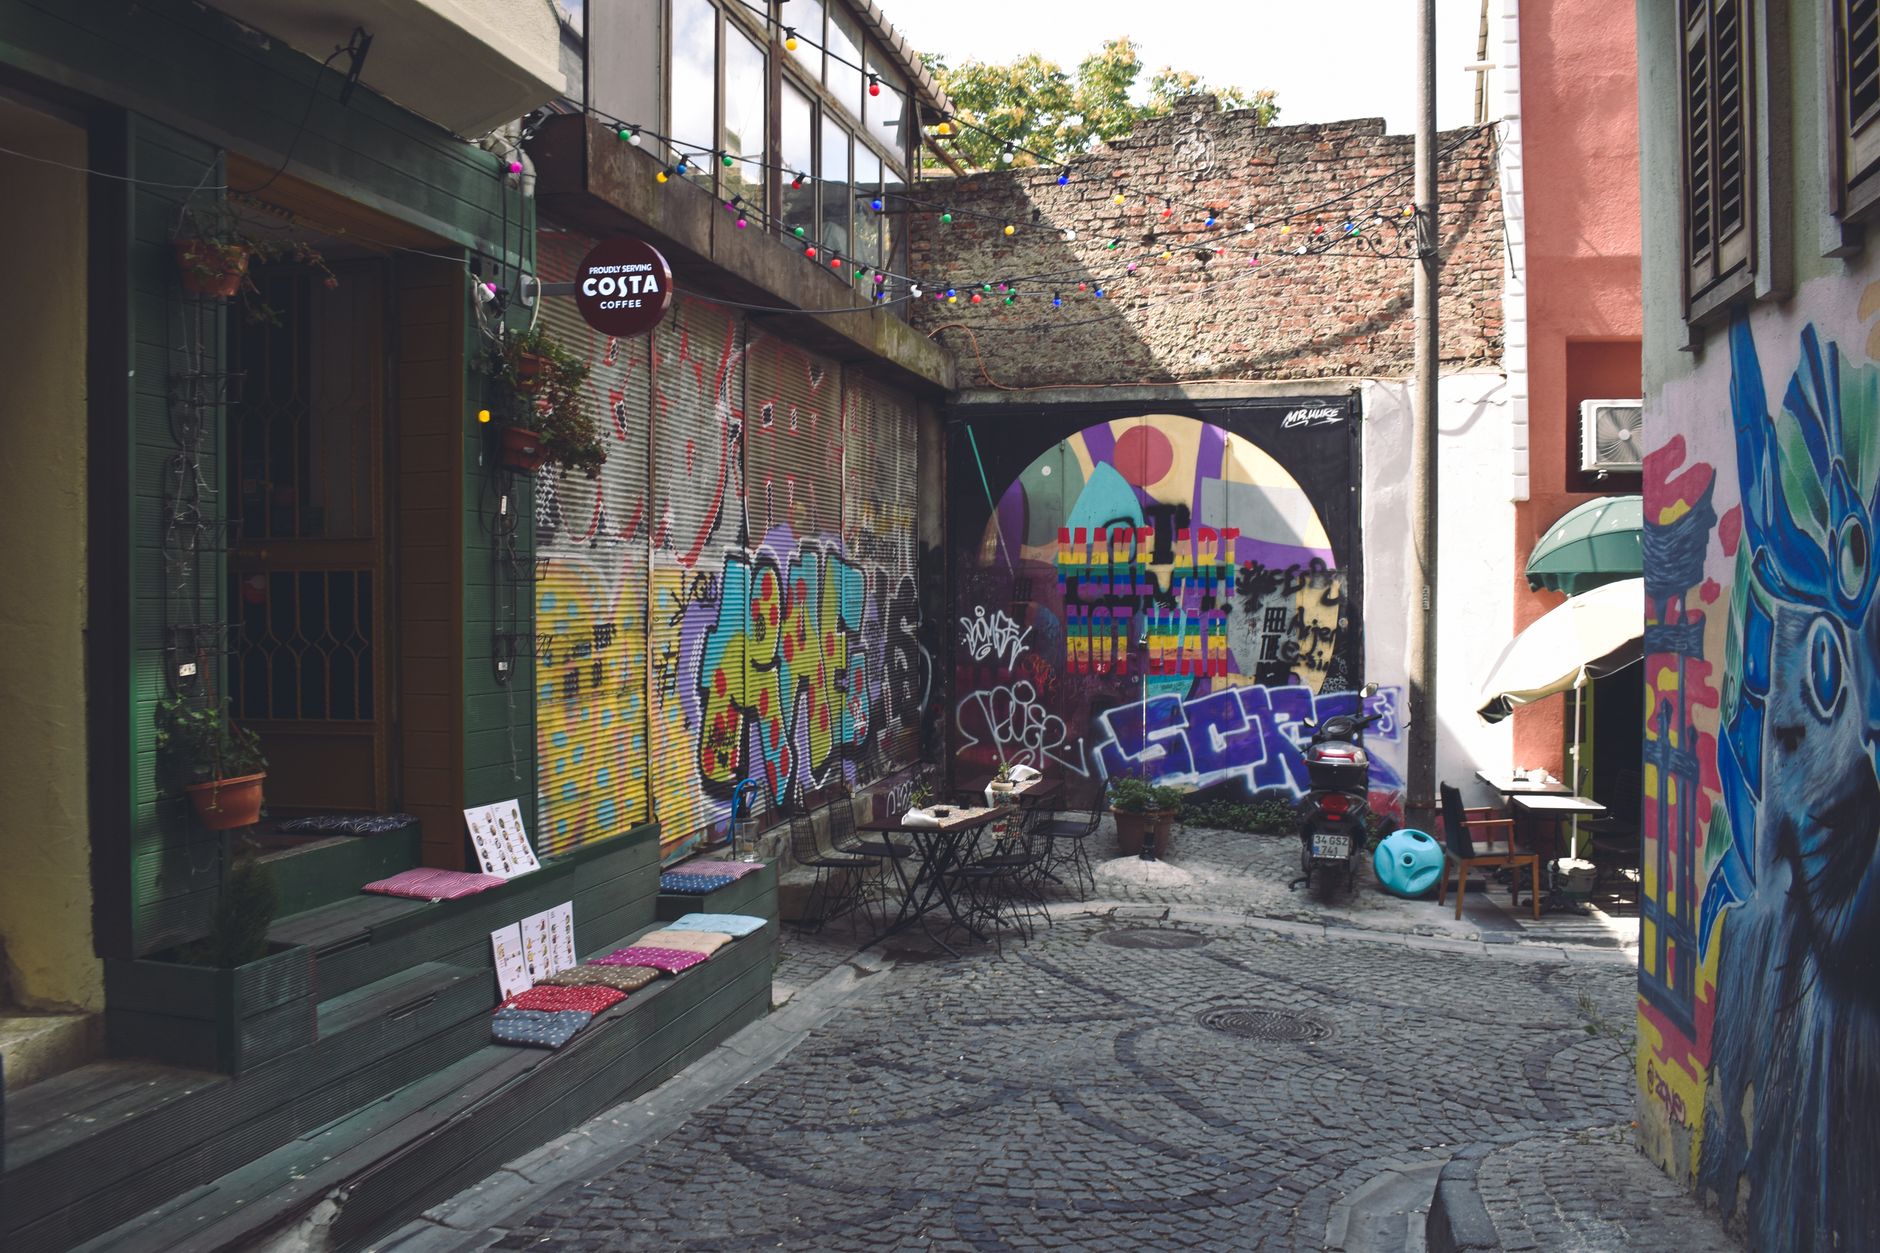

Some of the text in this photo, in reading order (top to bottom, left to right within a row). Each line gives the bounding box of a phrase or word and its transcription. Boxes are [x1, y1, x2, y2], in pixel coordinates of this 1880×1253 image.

[589, 263, 652, 274] PROUDLY SERVING
[582, 274, 659, 298] COSTA
[600, 299, 642, 310] COFFEE
[1057, 527, 1154, 596] MAKE
[1172, 527, 1240, 598] ART
[1066, 604, 1133, 676] NOT
[1146, 607, 1227, 678] WAR
[1314, 835, 1348, 846] 34 GSZ
[1321, 846, 1338, 854] 741
